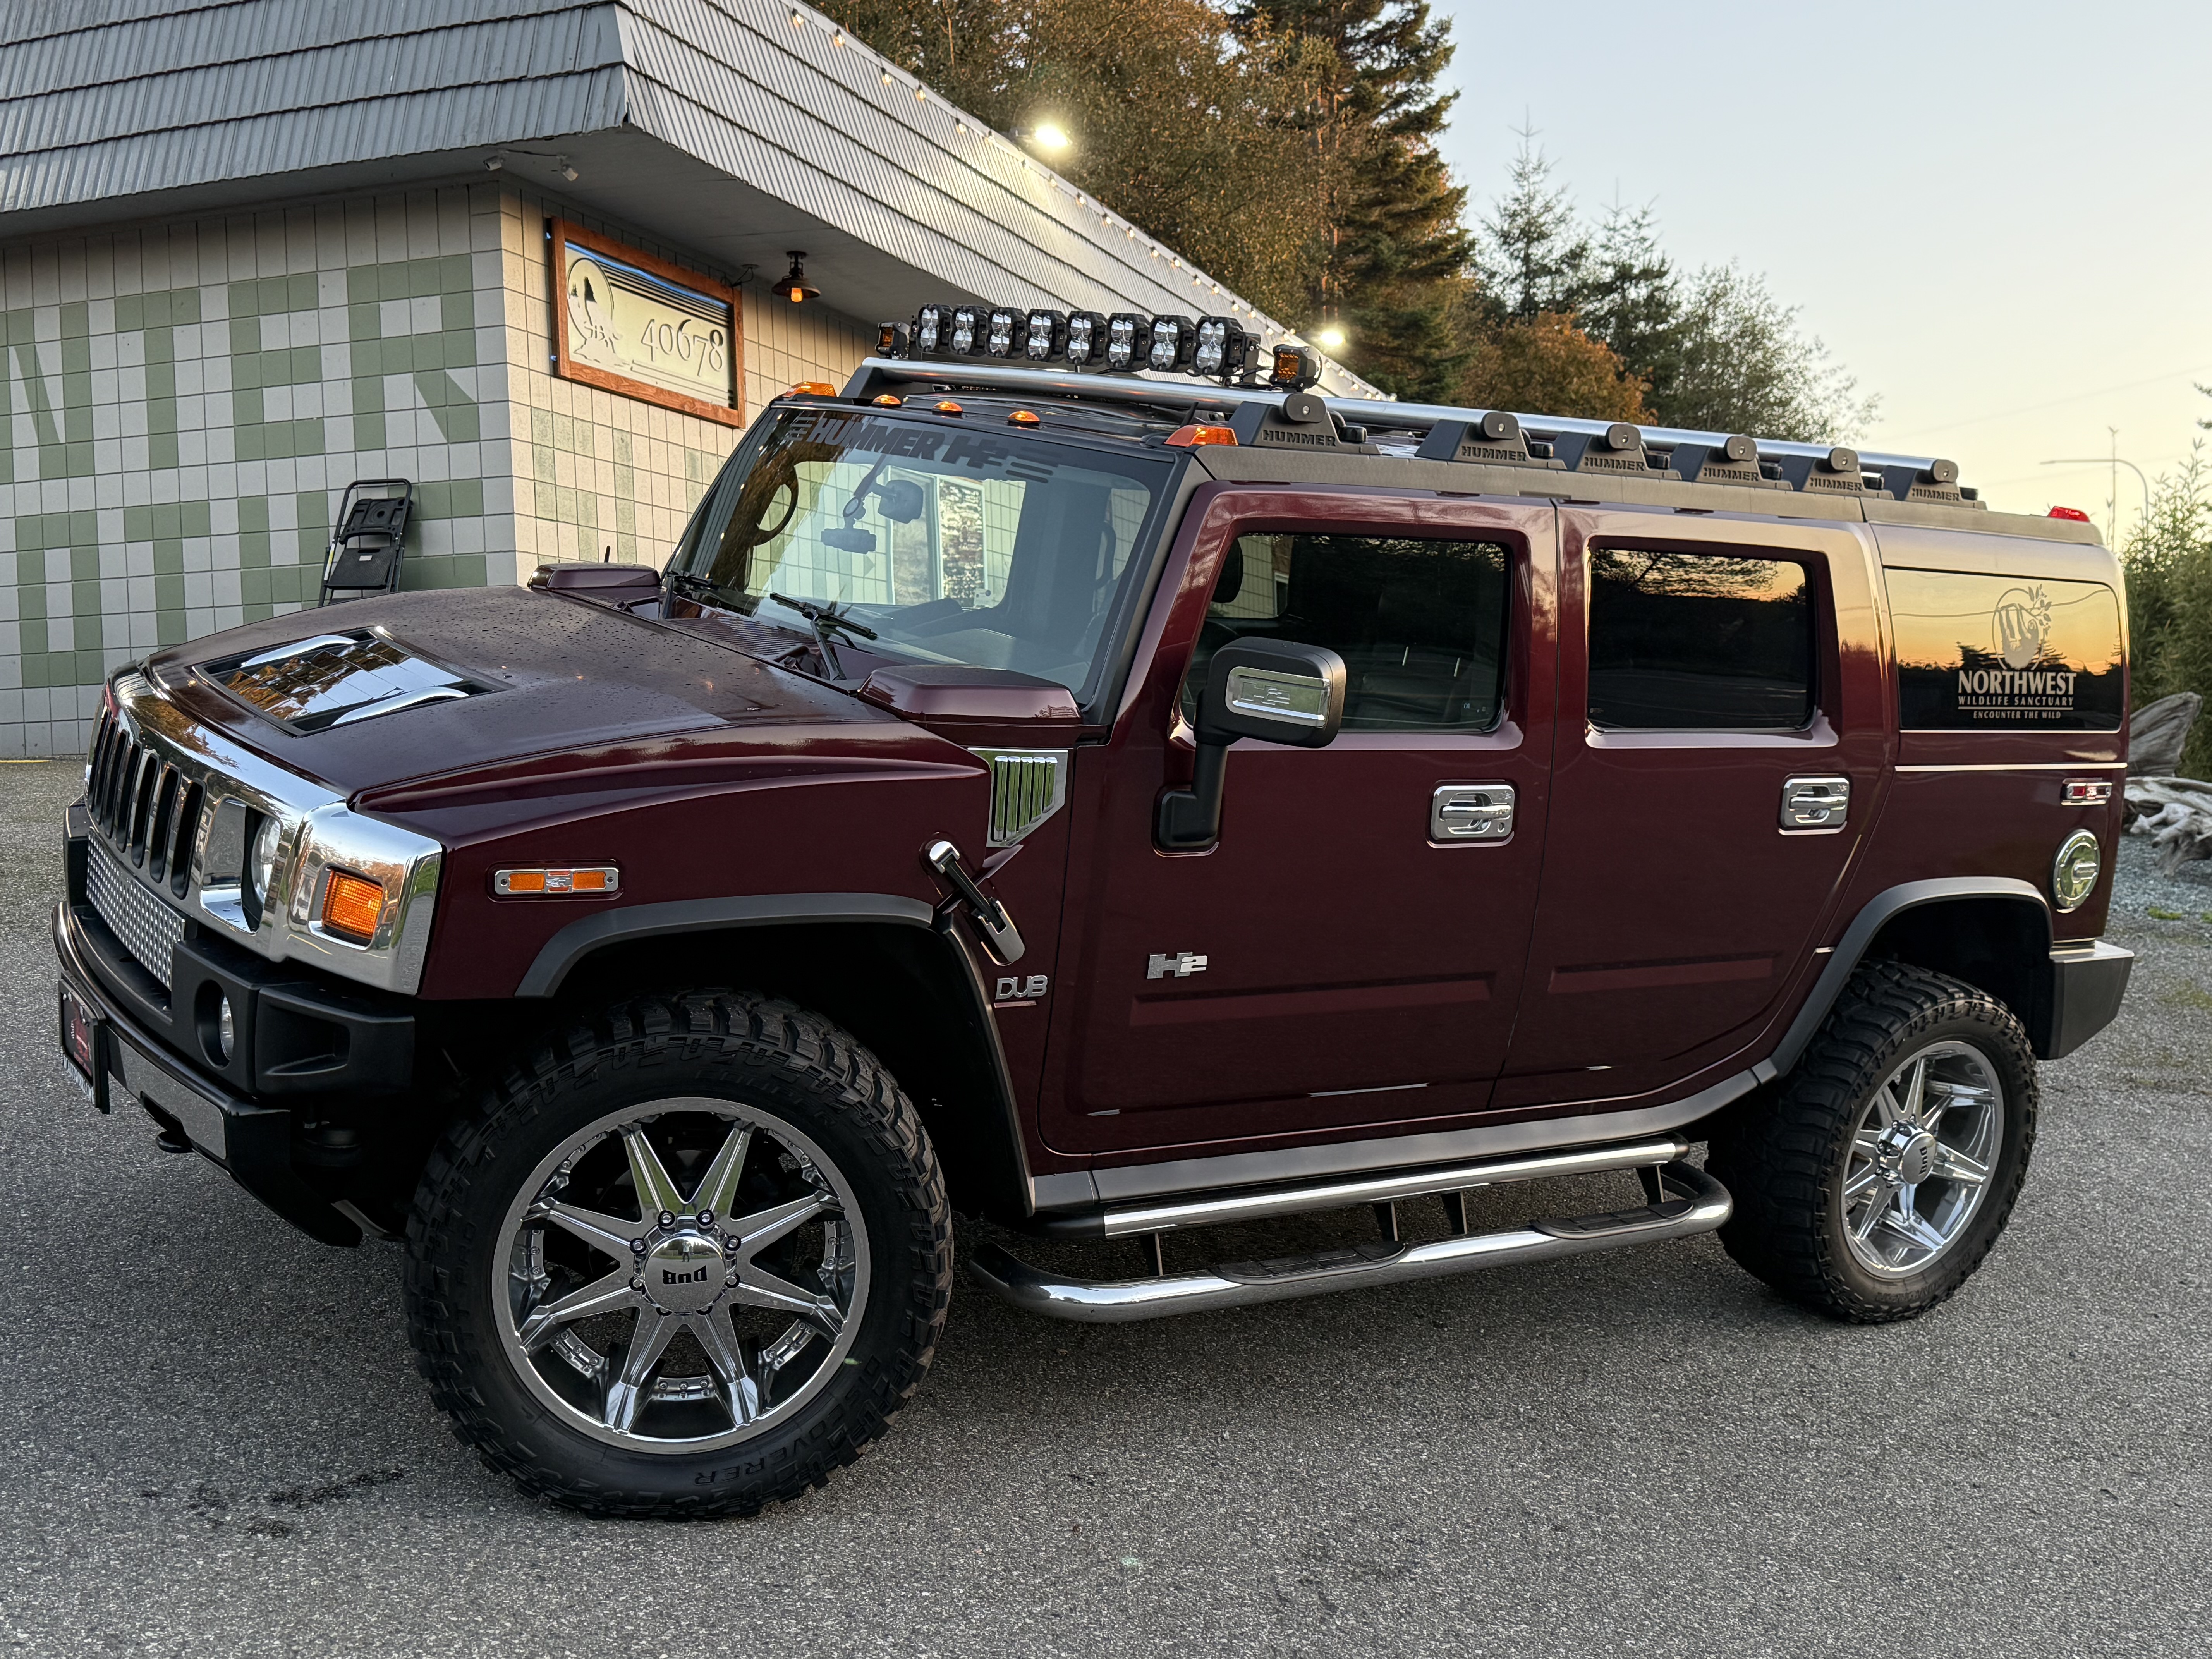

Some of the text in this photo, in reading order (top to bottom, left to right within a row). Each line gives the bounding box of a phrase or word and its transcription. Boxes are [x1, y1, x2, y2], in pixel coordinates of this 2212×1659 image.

[641, 318, 723, 377] 40678
[807, 417, 945, 461] HUMMER
[1262, 429, 1336, 447] HUMMER
[1461, 445, 1527, 462] HUMMER
[1584, 456, 1645, 471] HUMMER
[1703, 467, 1759, 482] HUMMER
[1810, 477, 1862, 491] HUMMER
[1911, 488, 1960, 502] HUMMER
[1958, 670, 2077, 695] NORTHWEST
[1958, 696, 2074, 706] WILDLIFE SANCTUARY
[1973, 711, 2021, 719] ENCOUNTER
[1147, 952, 1207, 979] H2
[995, 975, 1048, 1000] DUB
[662, 1265, 708, 1285] DUB
[693, 1353, 883, 1486] DISCOVERER
